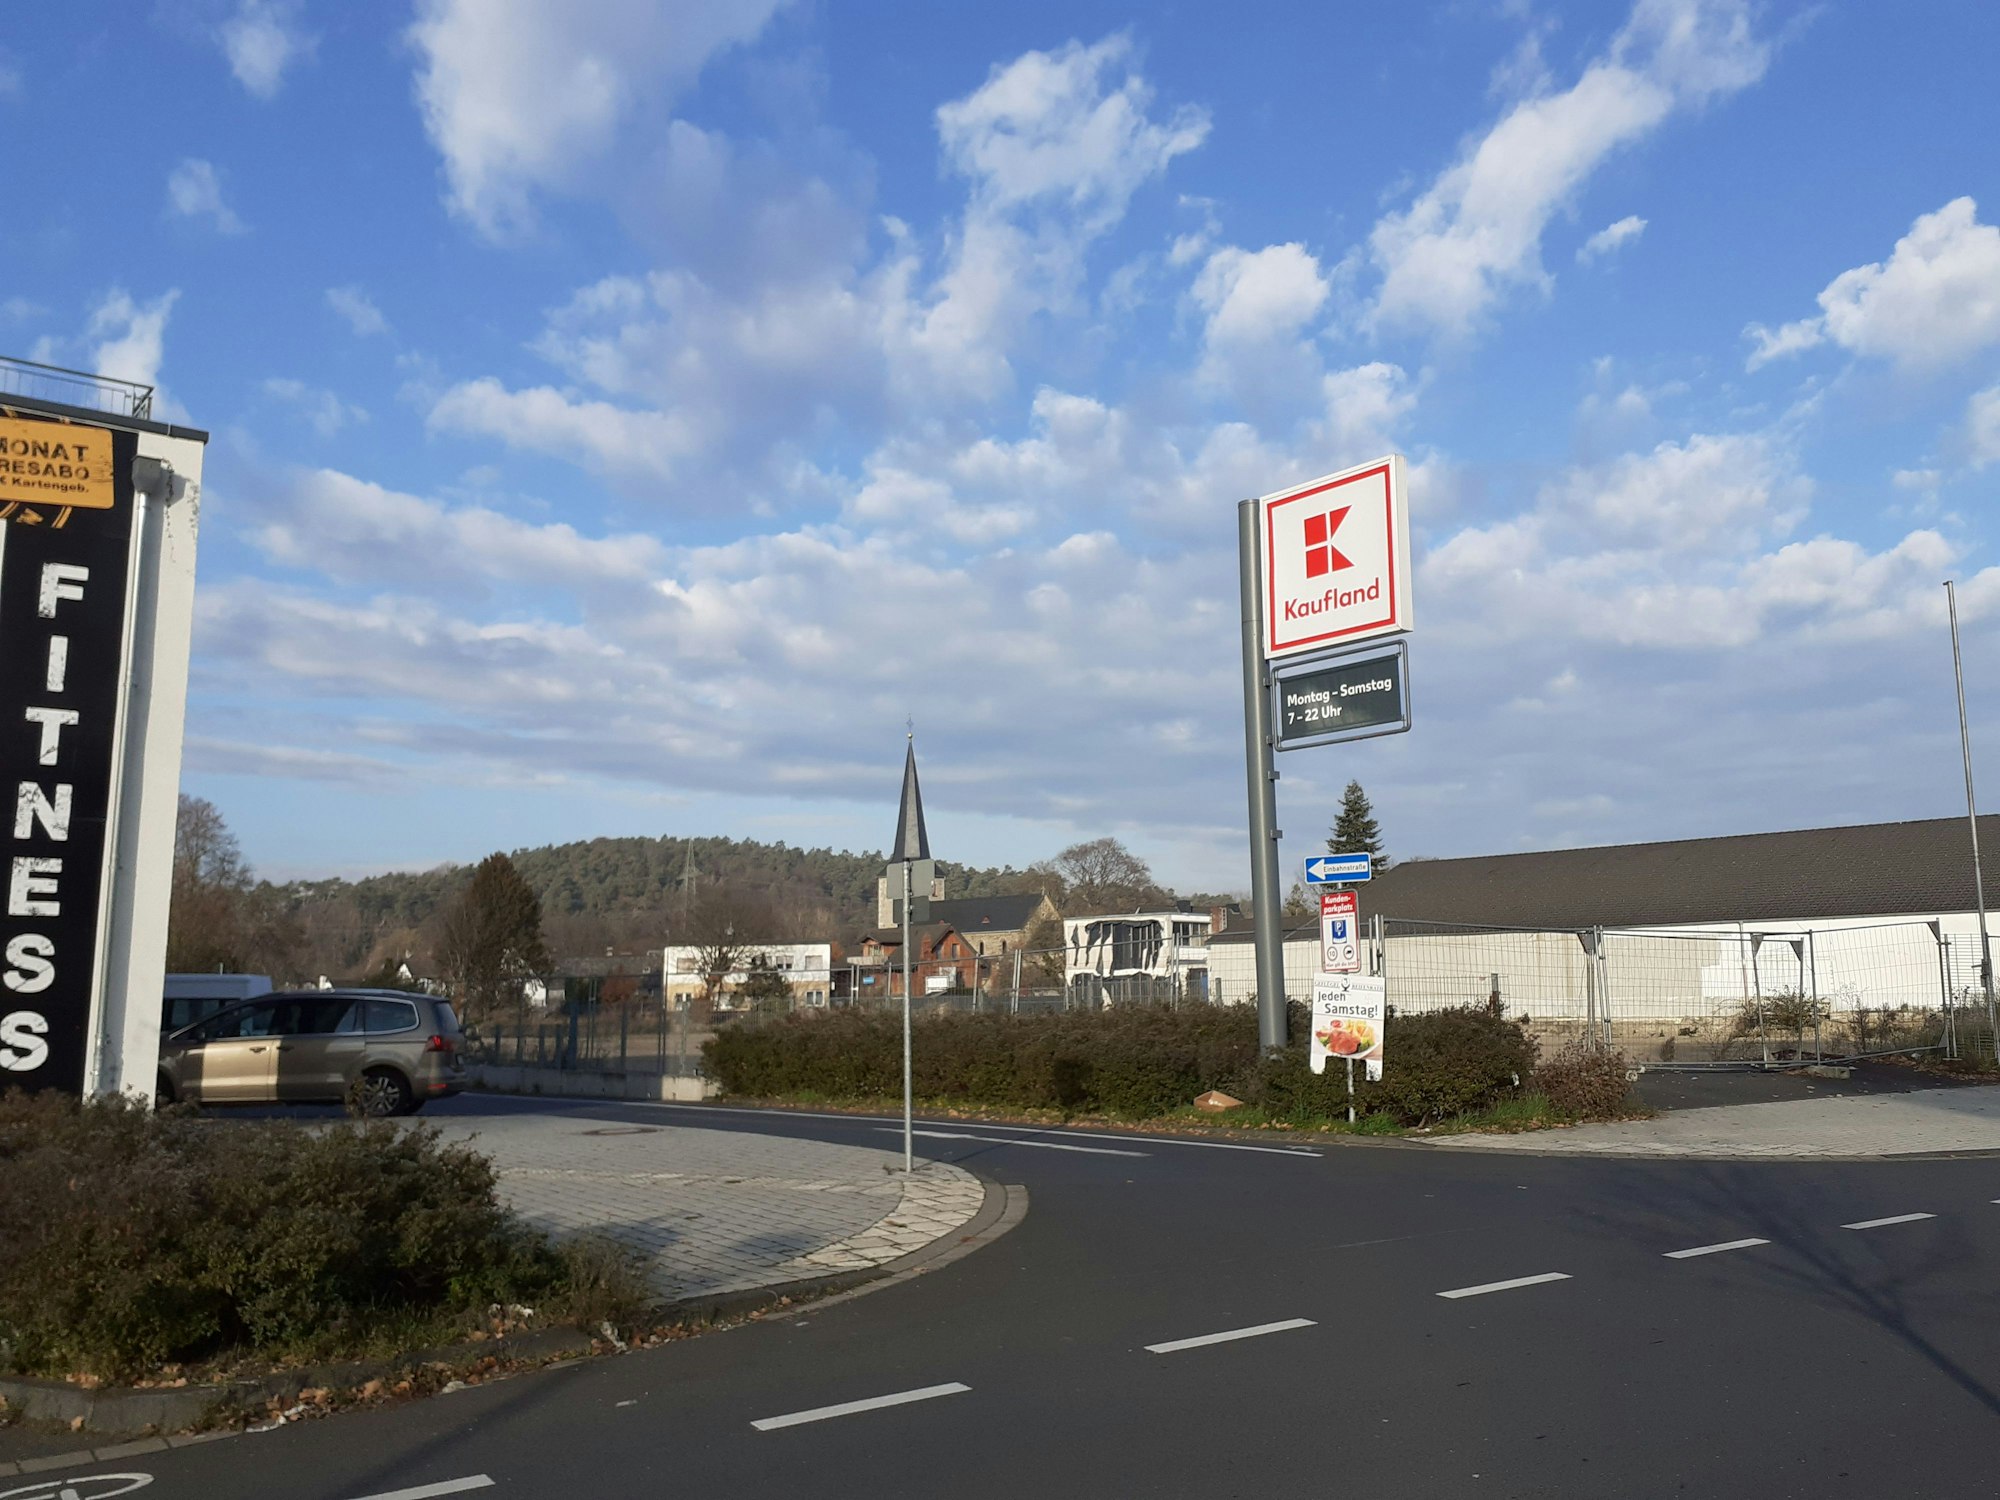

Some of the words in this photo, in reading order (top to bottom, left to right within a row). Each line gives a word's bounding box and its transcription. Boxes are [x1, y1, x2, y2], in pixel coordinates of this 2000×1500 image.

[12, 476, 89, 493] Kartengeb.
[1284, 577, 1380, 621] Kaufland
[1287, 691, 1330, 707] Montag
[1340, 678, 1392, 697] Samstag
[1321, 705, 1342, 719] Uhr
[0, 563, 90, 1072] FITNESS
[1323, 863, 1367, 873] Einbahnstraße
[1323, 904, 1354, 915] parkplatz
[1318, 991, 1346, 1002] Jeden
[1325, 1003, 1378, 1018] Samstag!
